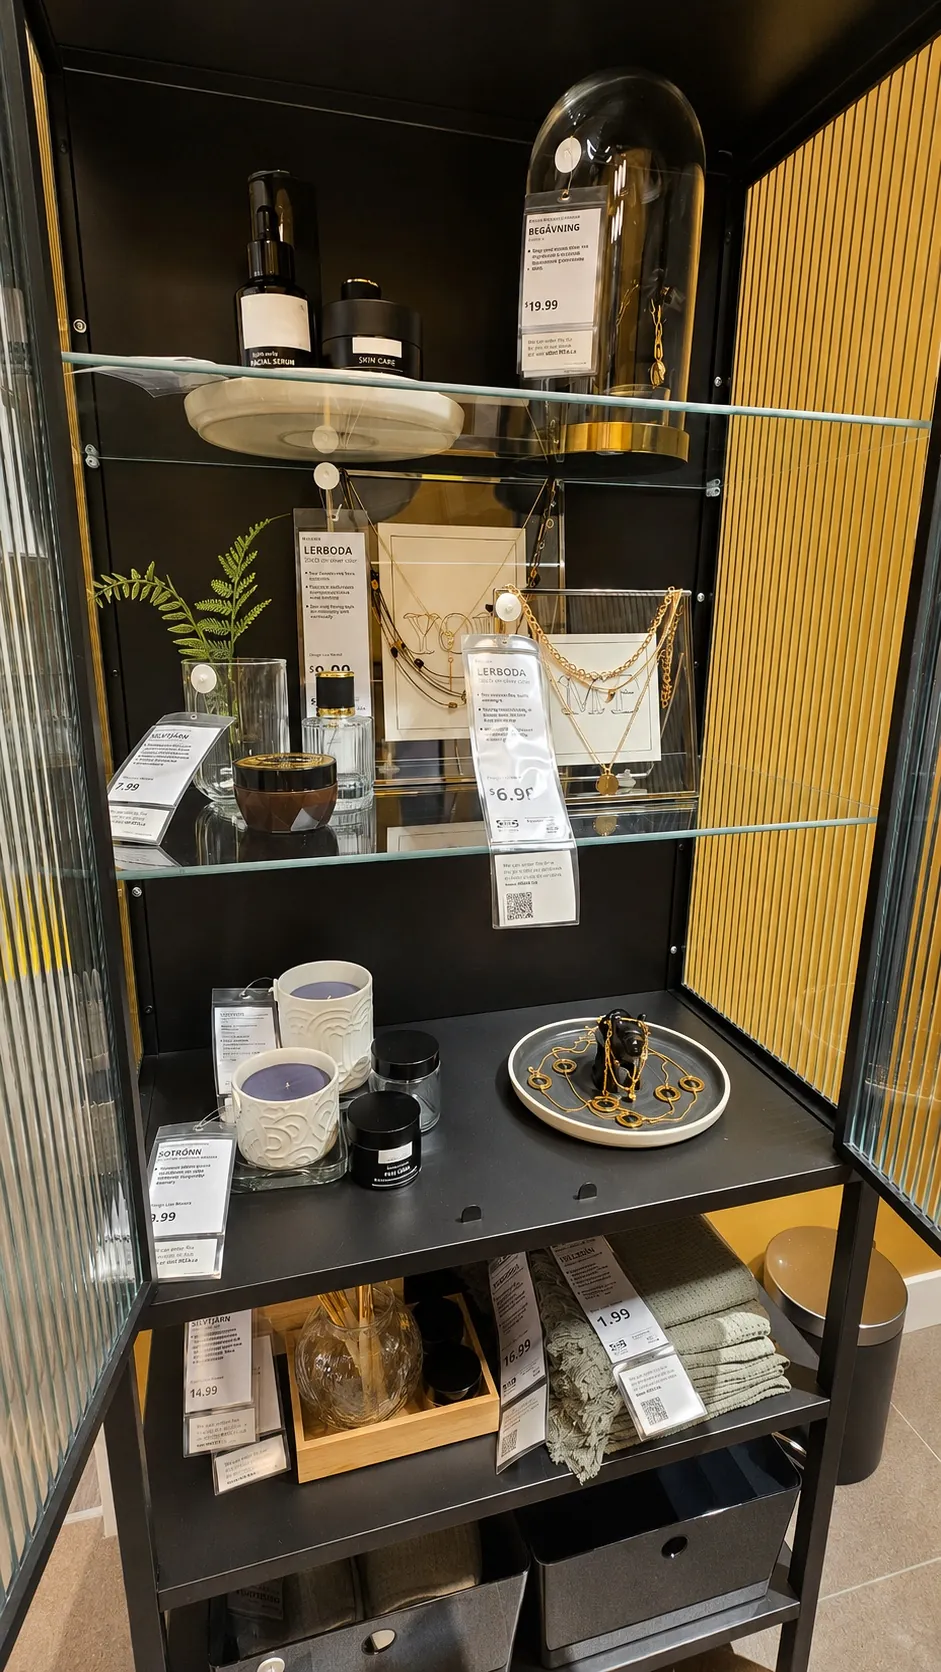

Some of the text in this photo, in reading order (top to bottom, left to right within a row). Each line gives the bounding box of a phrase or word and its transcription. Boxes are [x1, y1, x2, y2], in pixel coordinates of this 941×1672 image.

[529, 223, 580, 236] BEGÅVNING
[525, 299, 558, 312] $19.99
[358, 356, 395, 367] SKIN CARE
[304, 546, 353, 556] LERBODA
[477, 667, 527, 677] LERBODA
[115, 783, 140, 791] 7.99
[597, 1307, 631, 1328] 1.99
[503, 1338, 531, 1367] 16.99
[190, 1385, 218, 1399] 14.99
